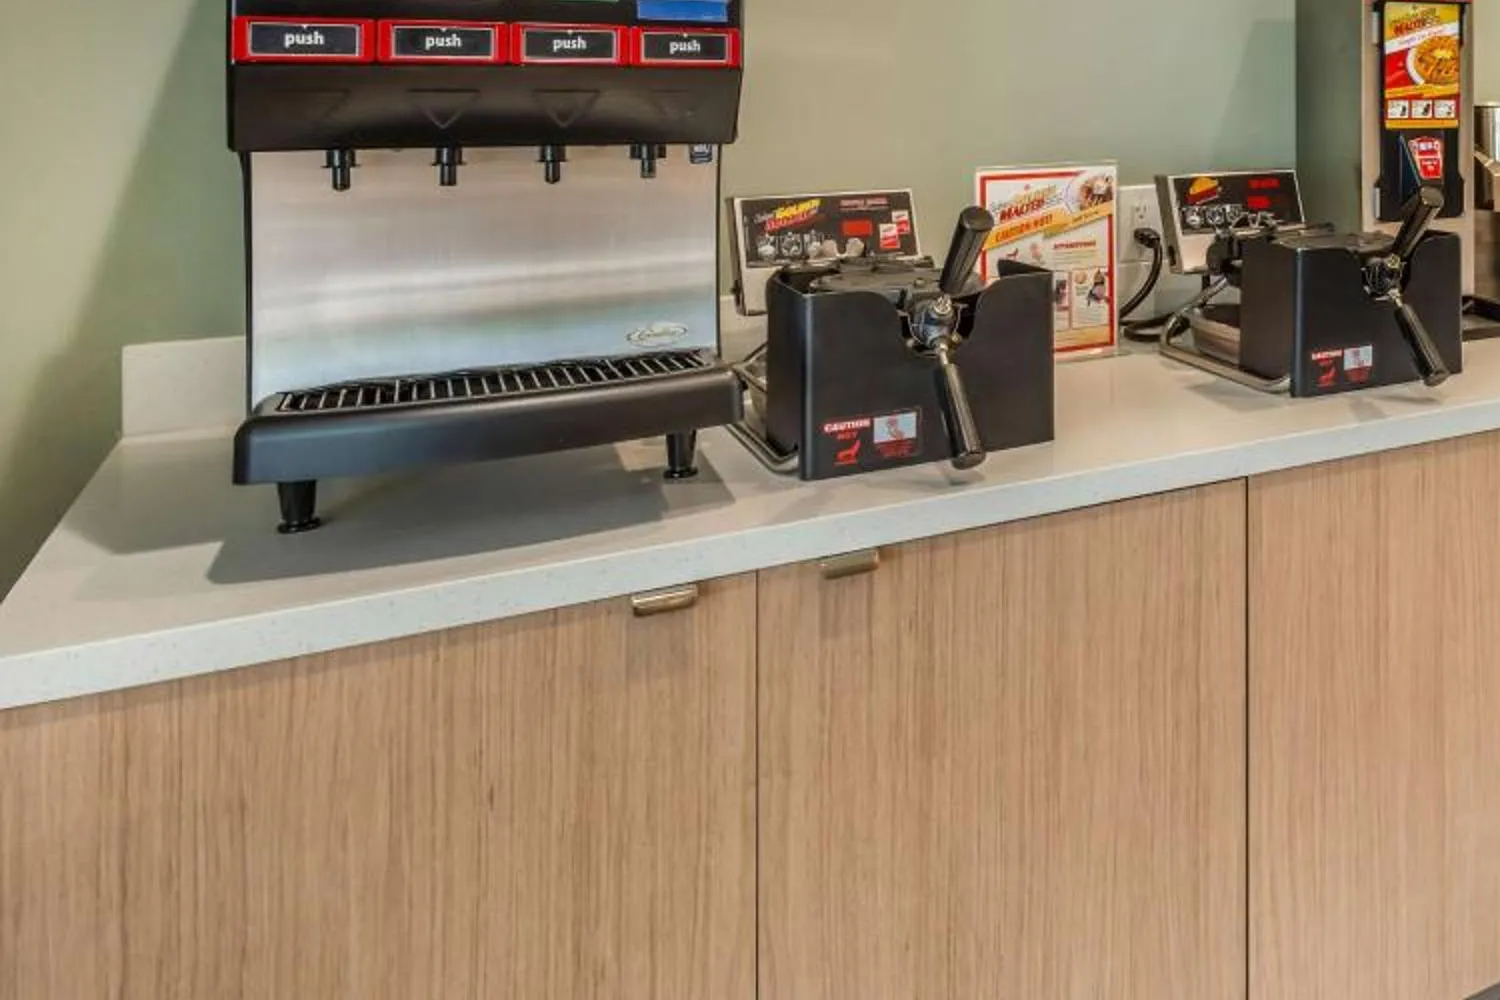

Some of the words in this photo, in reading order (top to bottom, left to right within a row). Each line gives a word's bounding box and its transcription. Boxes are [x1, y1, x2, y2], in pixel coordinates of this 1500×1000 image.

[284, 31, 325, 48] push
[425, 33, 462, 50] push
[552, 35, 587, 53] push
[669, 40, 701, 55] push
